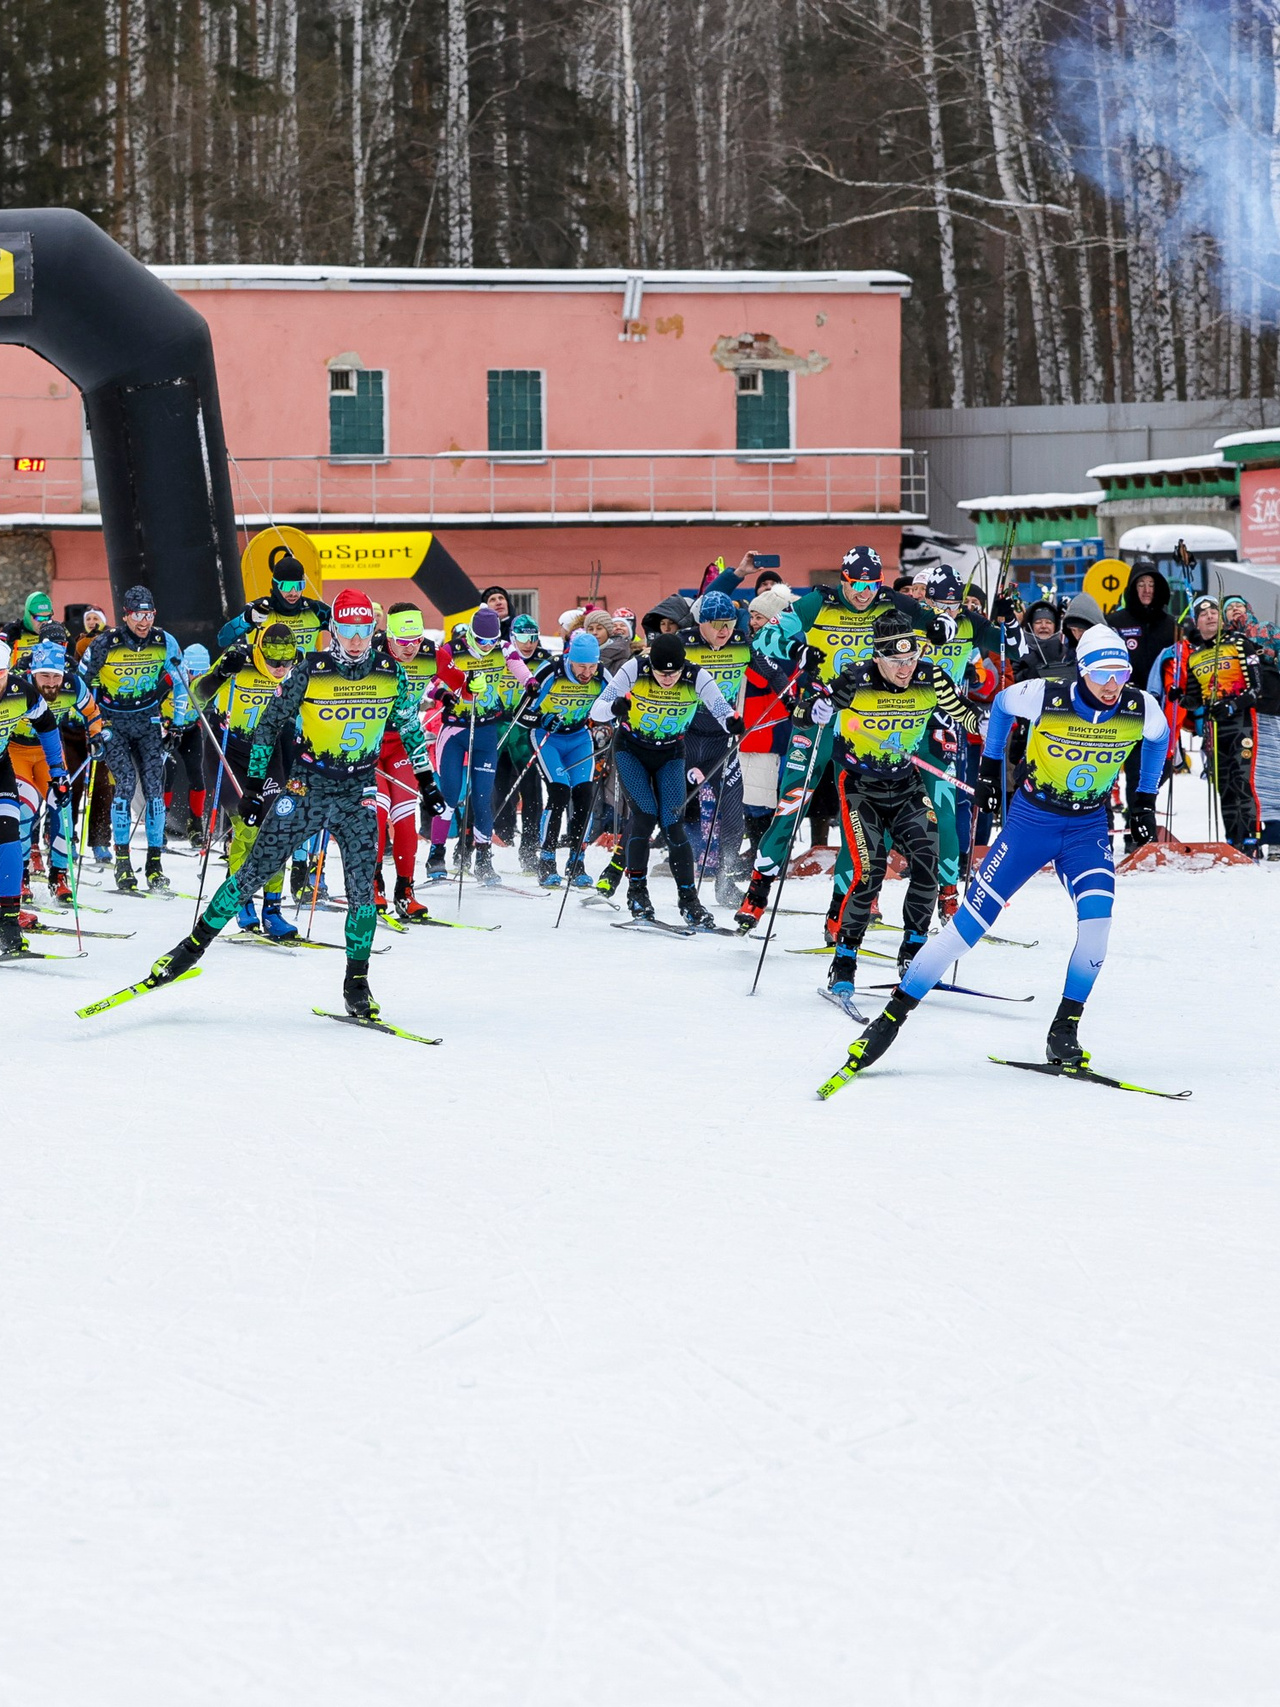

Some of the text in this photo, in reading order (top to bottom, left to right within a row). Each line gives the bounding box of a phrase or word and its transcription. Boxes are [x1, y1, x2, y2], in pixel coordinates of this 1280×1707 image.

[320, 544, 413, 562] oSport
[1102, 574, 1120, 592] Ф
[827, 633, 874, 647] сога
[113, 664, 159, 676] согаз
[240, 693, 271, 706] сог
[319, 706, 388, 721] согаз
[636, 702, 688, 716] согаз
[639, 713, 680, 733] 55
[863, 717, 926, 731] согаз
[1068, 726, 1118, 735] ВИКТОРИЯ
[340, 722, 366, 752] 5
[880, 731, 905, 754] 4
[1047, 744, 1126, 764] согаз
[726, 768, 742, 788] FALCO
[1066, 763, 1097, 793] 6
[983, 842, 1009, 883] #TIRUS
[972, 887, 986, 911] SKI
